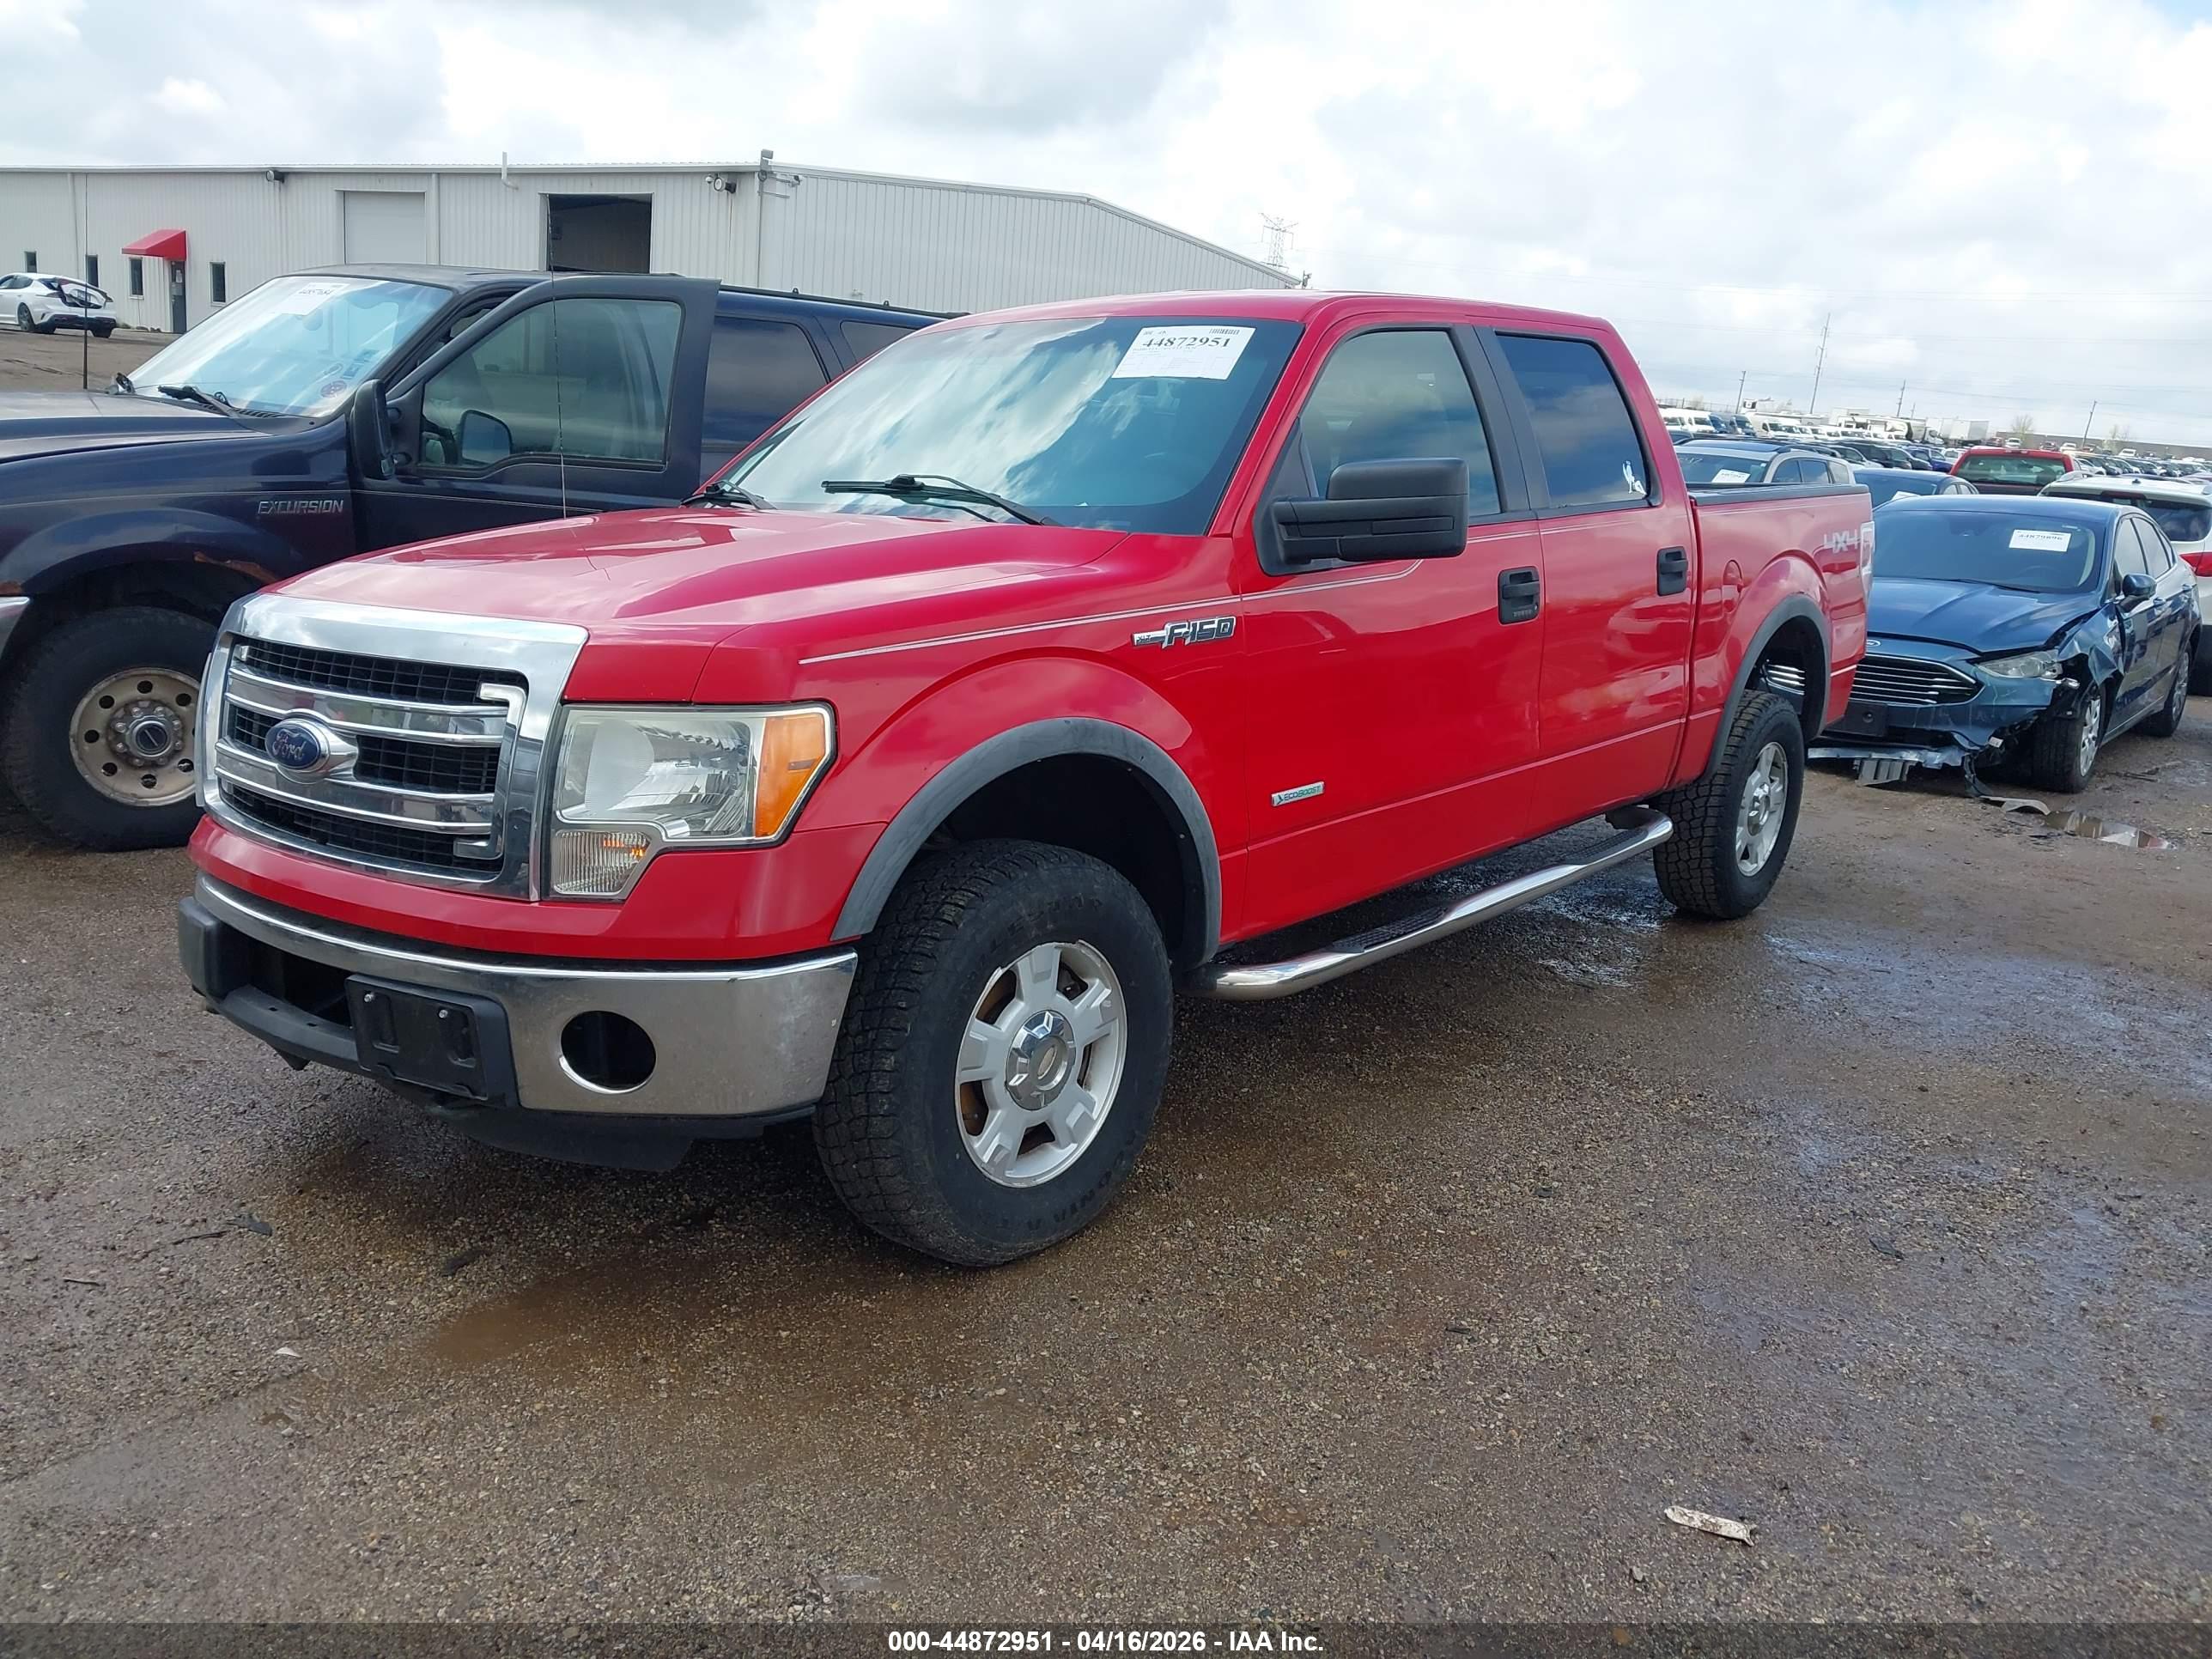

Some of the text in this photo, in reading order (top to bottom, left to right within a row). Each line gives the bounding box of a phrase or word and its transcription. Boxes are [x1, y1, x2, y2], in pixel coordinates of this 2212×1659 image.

[1142, 337, 1231, 348] 44872951
[258, 500, 344, 514] EXCURSION
[271, 728, 307, 761] Ford
